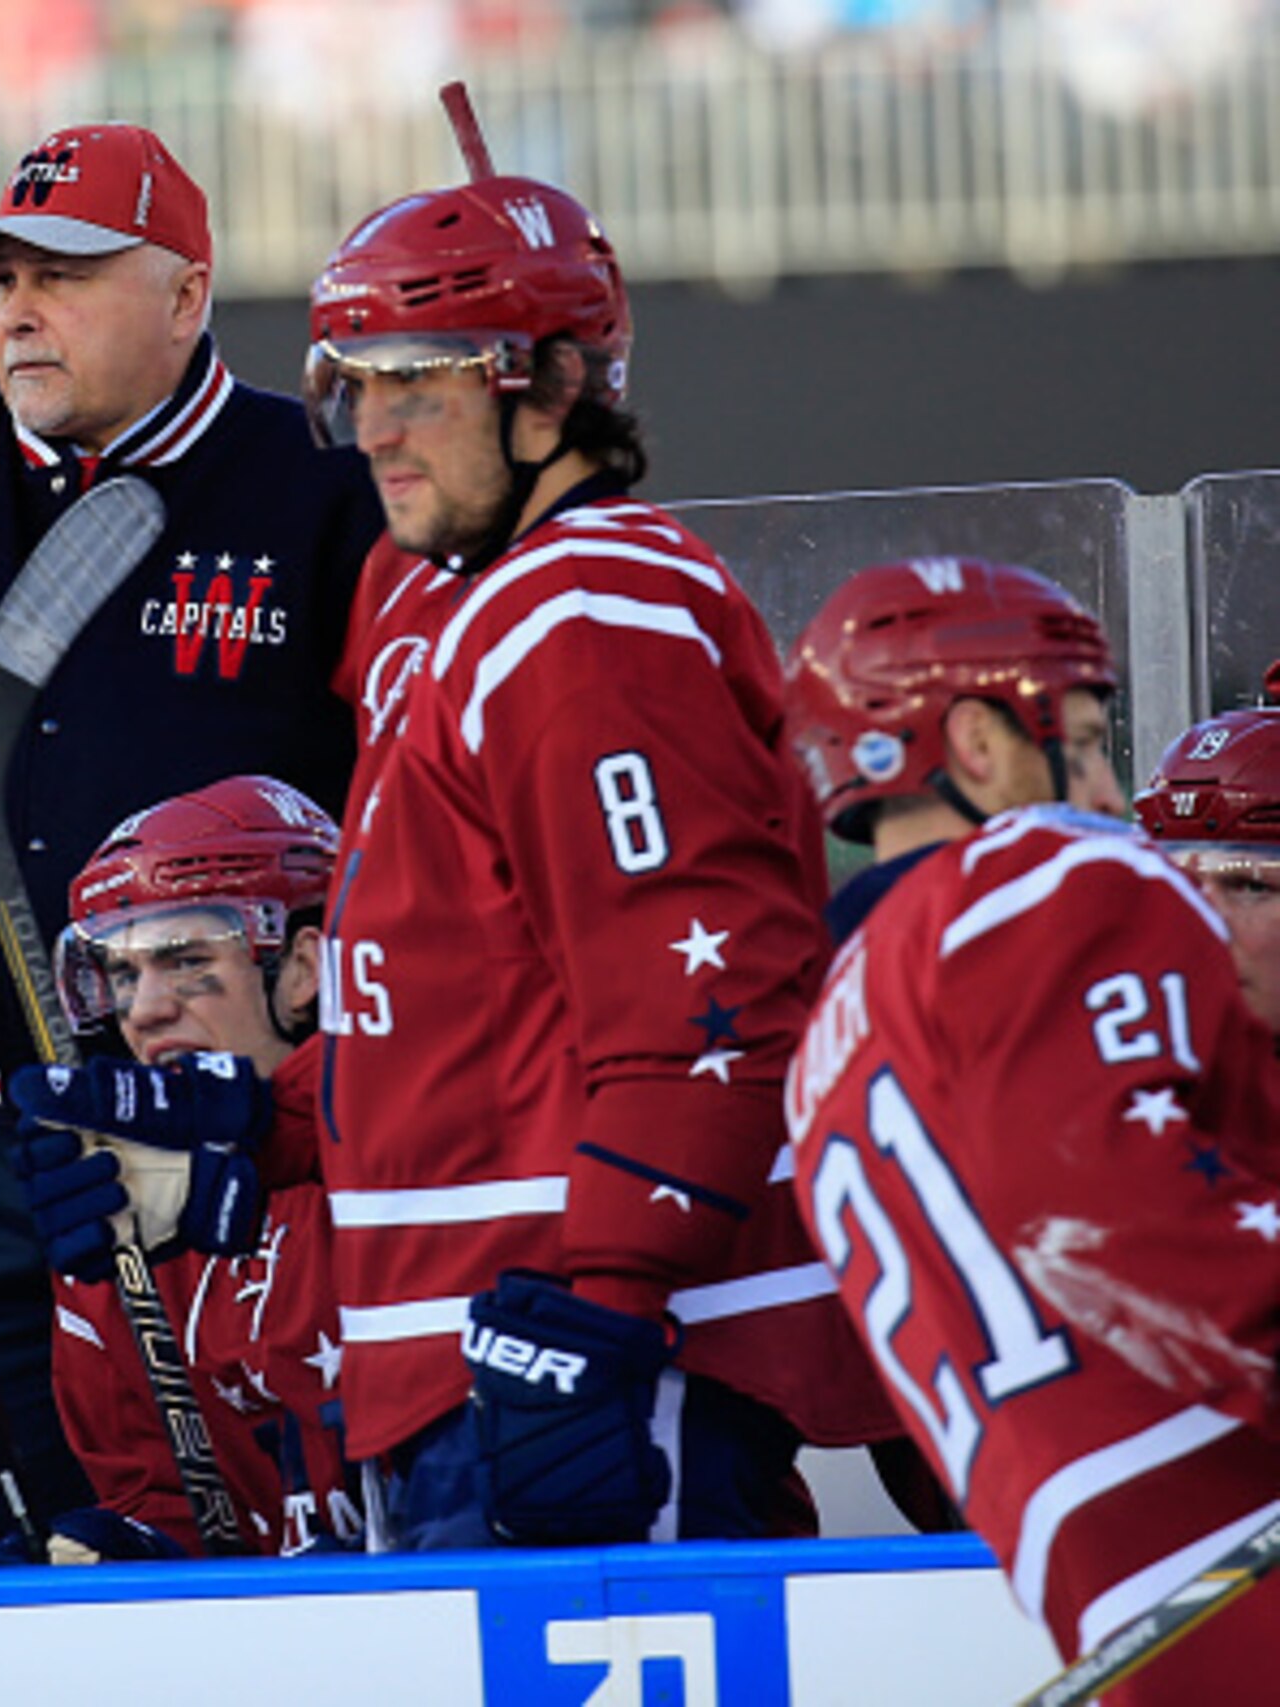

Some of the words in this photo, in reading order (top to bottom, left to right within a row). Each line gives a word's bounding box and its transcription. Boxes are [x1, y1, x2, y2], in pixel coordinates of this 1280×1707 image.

[140, 599, 287, 646] CAPITALS
[593, 750, 670, 875] 8
[1084, 972, 1203, 1072] 21
[812, 1062, 1082, 1502] 21
